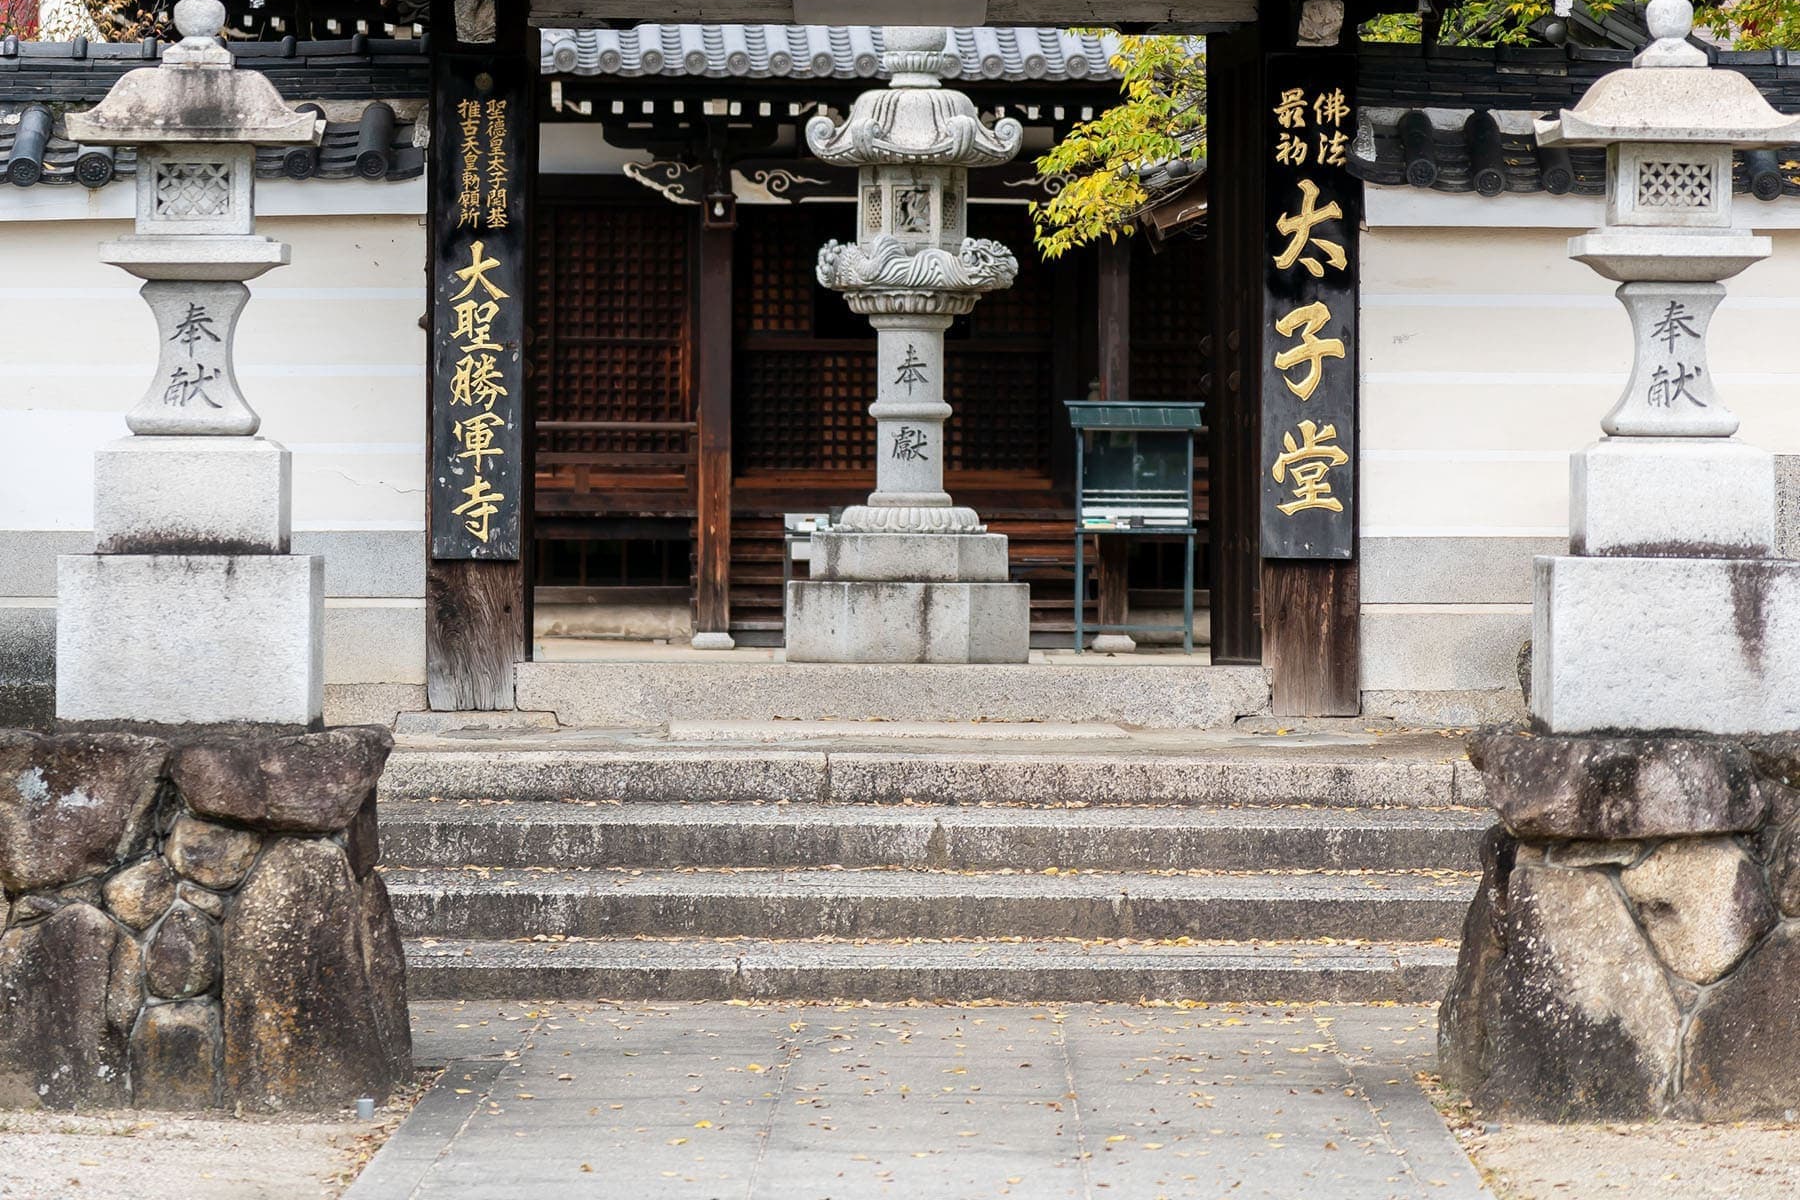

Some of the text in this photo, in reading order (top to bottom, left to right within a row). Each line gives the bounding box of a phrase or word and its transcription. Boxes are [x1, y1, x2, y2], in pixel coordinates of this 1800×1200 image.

[1313, 87, 1351, 167] 佛法
[163, 302, 223, 409] 奉献
[449, 240, 510, 543] 大聖勝軍寺
[1272, 178, 1349, 518] 太子堂
[1647, 300, 1708, 408] 奉献
